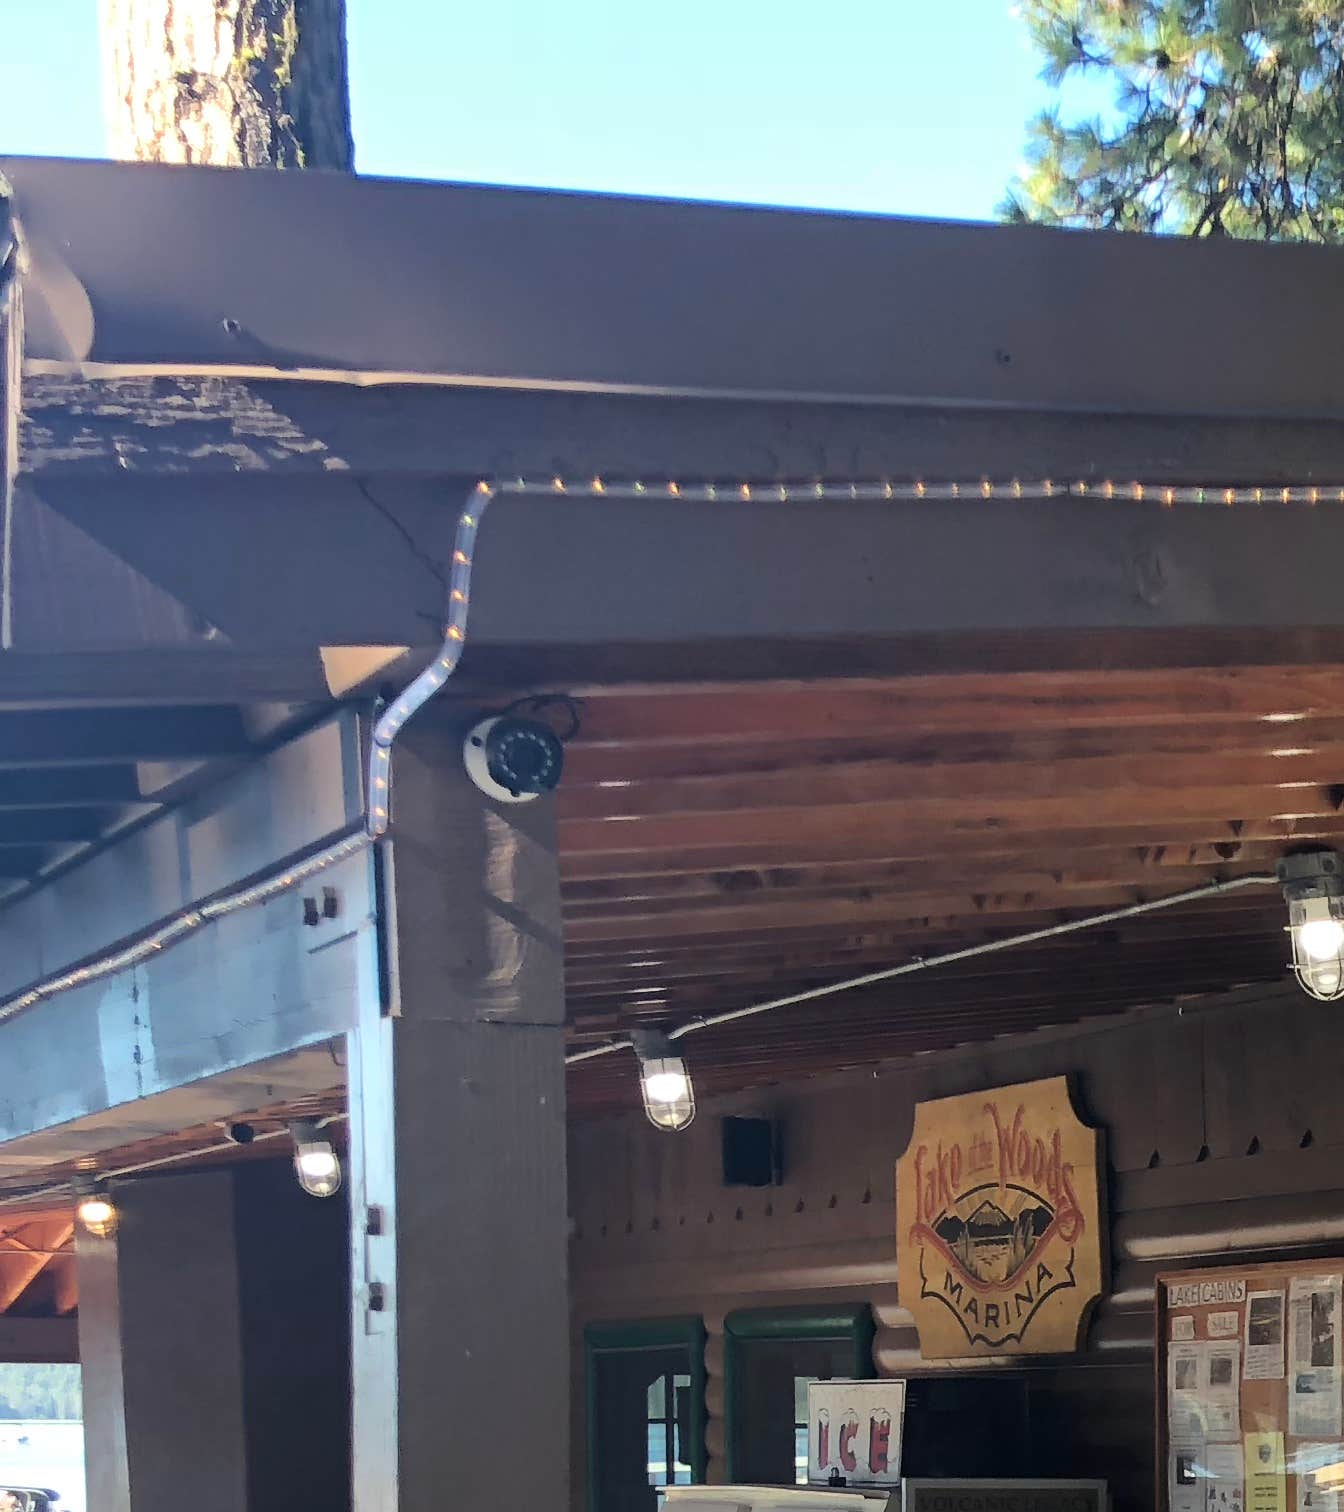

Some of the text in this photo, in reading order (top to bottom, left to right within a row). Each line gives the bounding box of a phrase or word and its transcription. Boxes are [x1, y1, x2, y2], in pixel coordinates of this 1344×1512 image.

[984, 1103, 1075, 1206] Woods
[944, 1261, 1053, 1328] MARINA
[1169, 1280, 1243, 1305] LAKE CABINS
[818, 1407, 893, 1475] ICE
